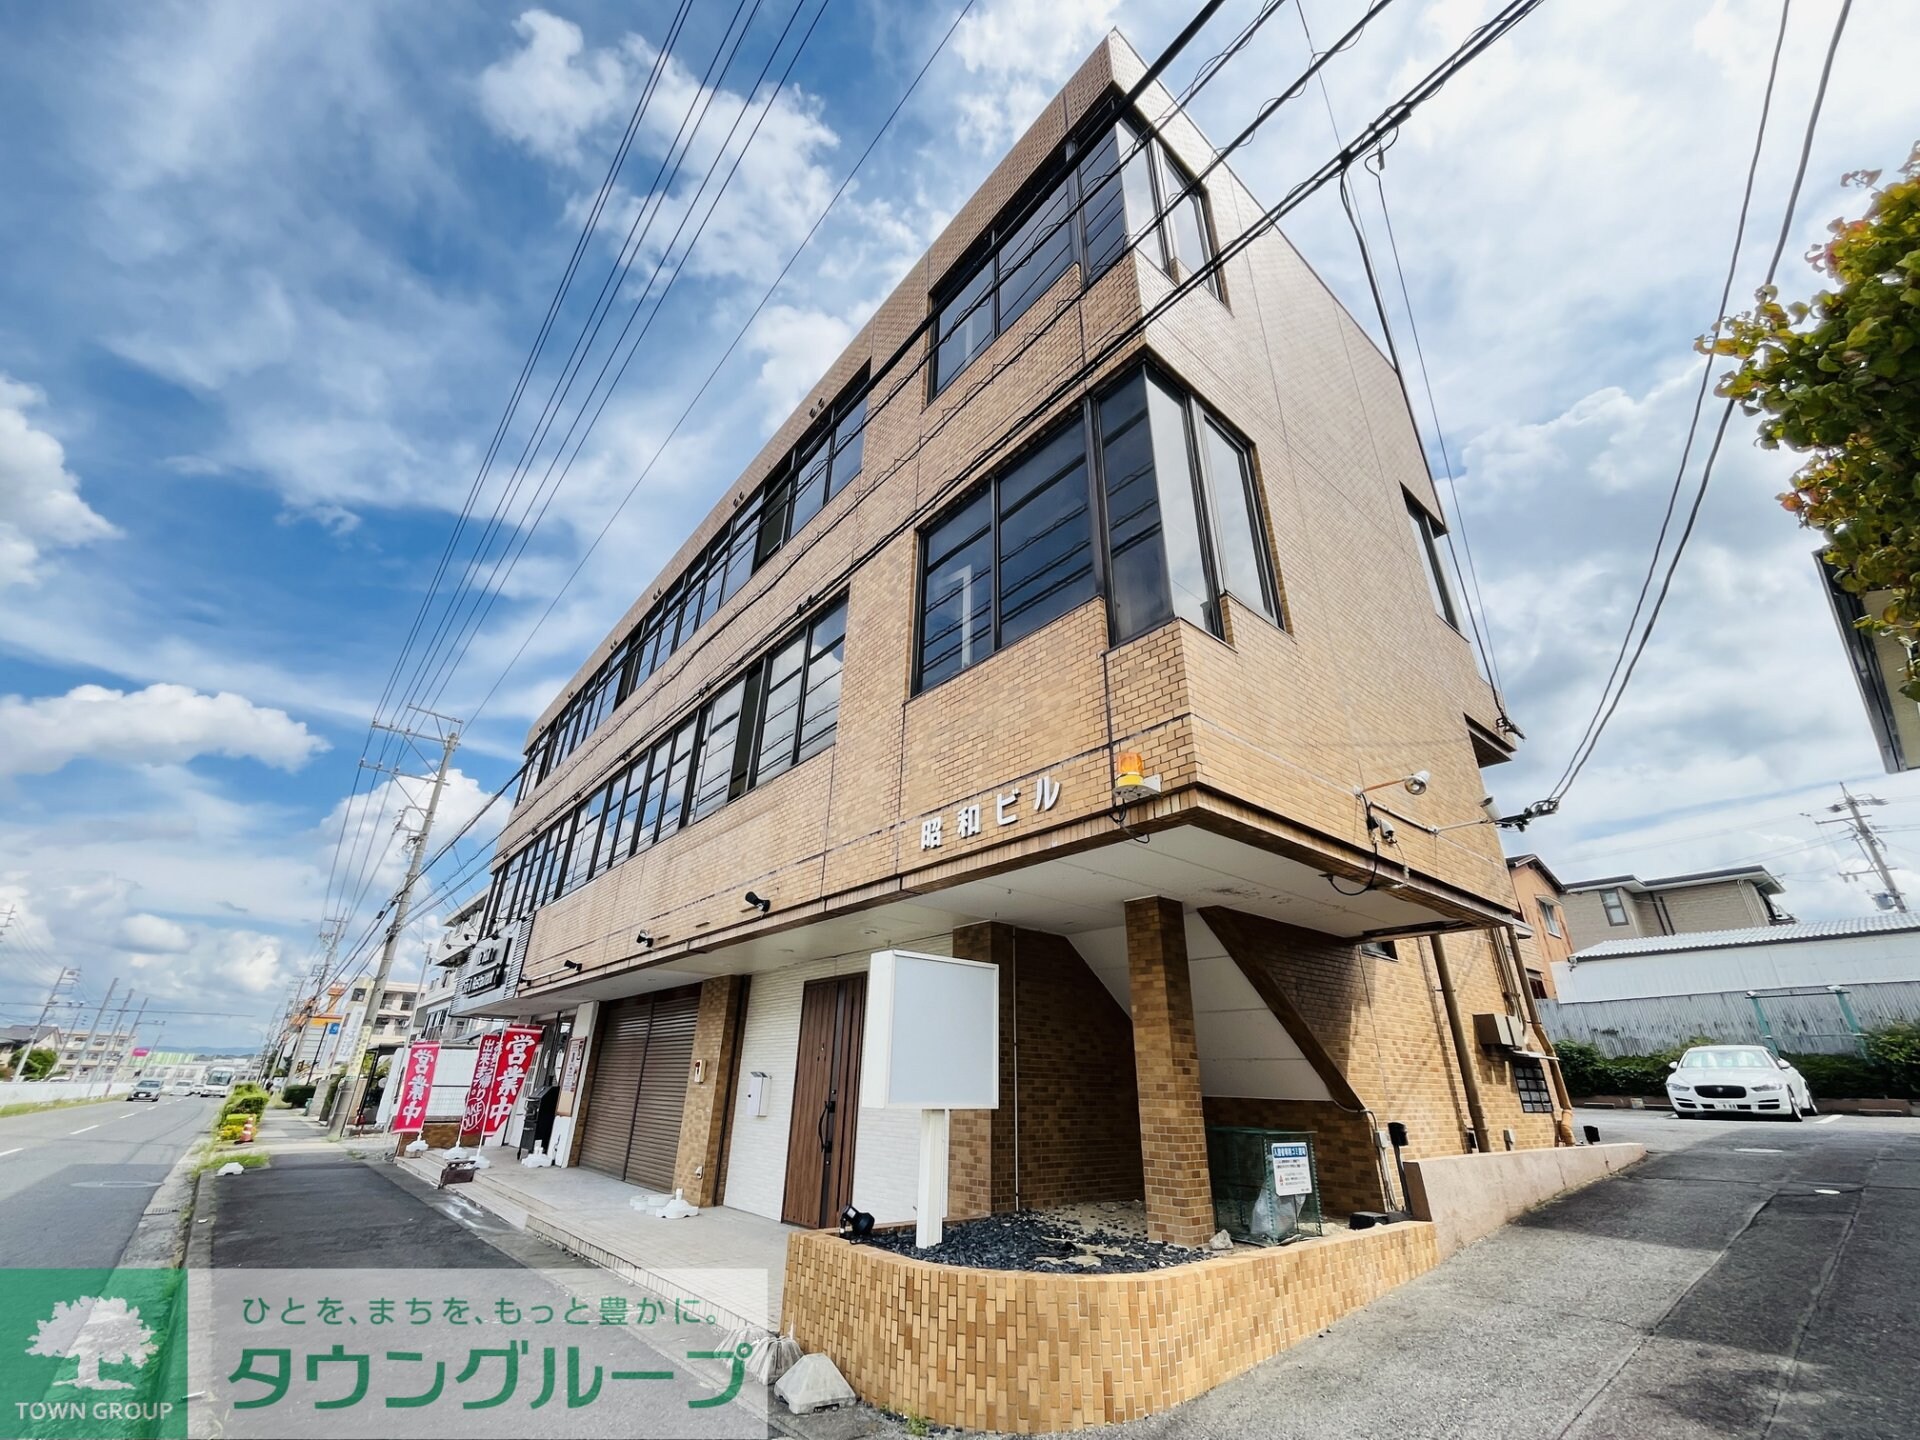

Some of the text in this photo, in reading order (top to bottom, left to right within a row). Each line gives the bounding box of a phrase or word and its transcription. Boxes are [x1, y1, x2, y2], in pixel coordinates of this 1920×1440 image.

[920, 775, 1062, 850] 昭和ビル
[402, 1049, 435, 1126] 営業中
[464, 1103, 483, 1116] AKE
[489, 1034, 536, 1127] 営業中
